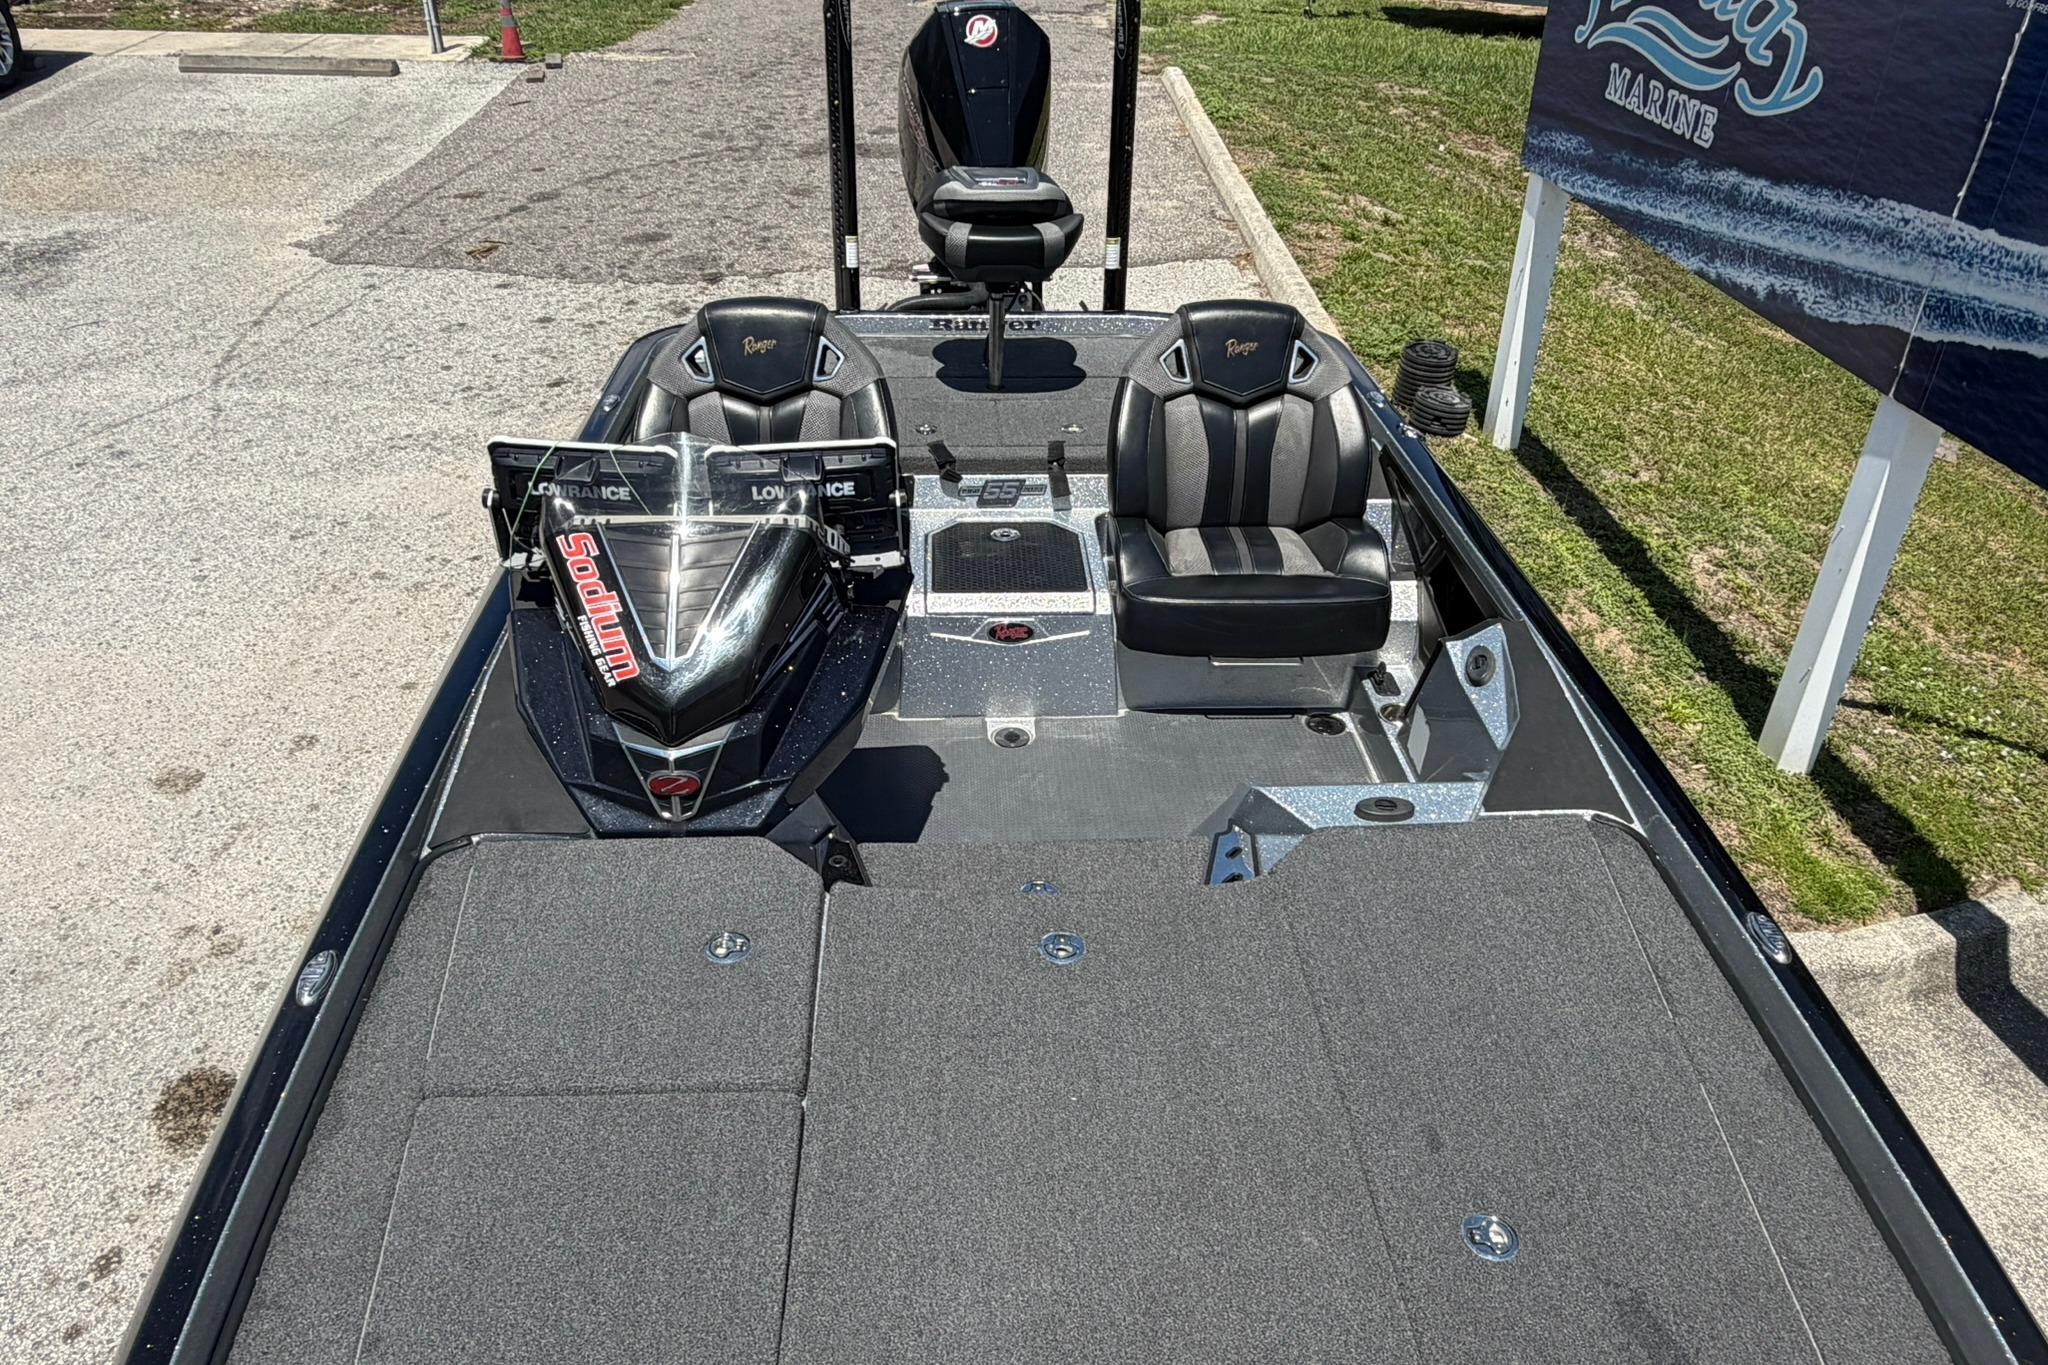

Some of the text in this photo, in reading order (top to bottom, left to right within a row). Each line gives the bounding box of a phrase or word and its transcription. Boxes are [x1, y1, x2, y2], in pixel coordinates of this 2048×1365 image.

[1605, 62, 1718, 149] MARINE
[929, 319, 1041, 331] Raner
[742, 336, 777, 356] Ranger
[1225, 338, 1260, 359] Ranger
[528, 481, 631, 501] LOWRANCE
[577, 614, 617, 688] FISHING GEAR
